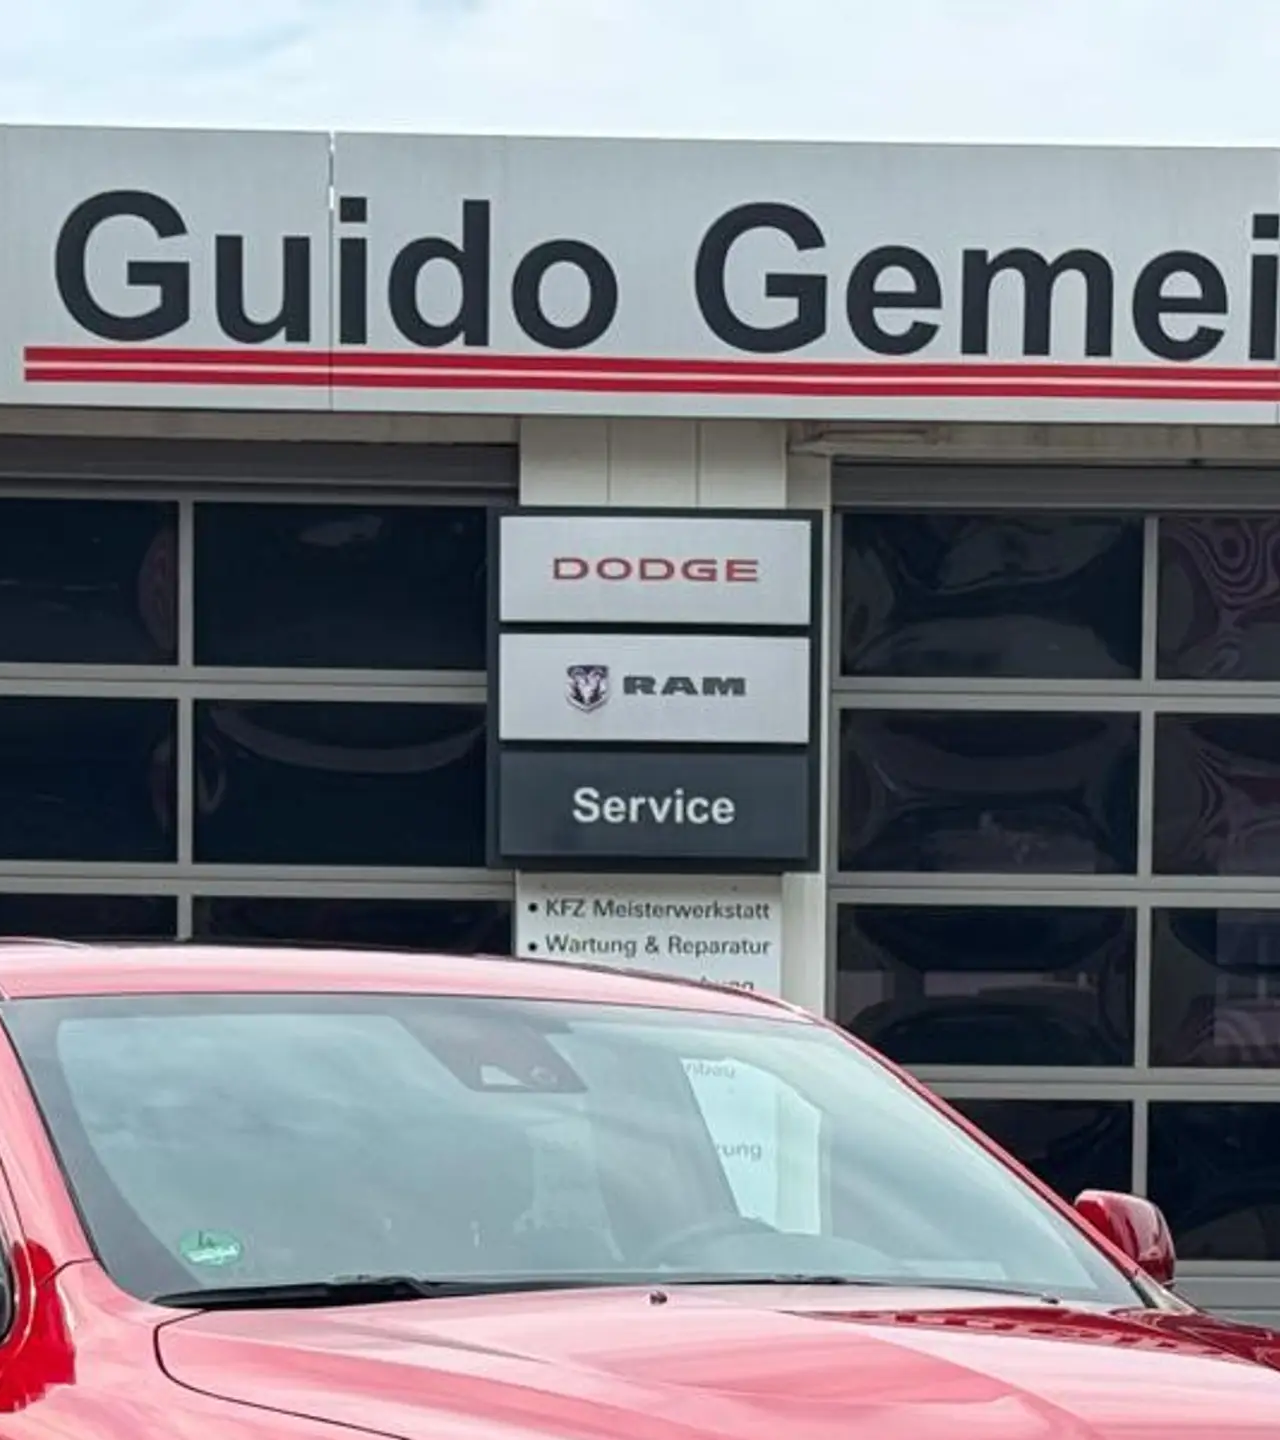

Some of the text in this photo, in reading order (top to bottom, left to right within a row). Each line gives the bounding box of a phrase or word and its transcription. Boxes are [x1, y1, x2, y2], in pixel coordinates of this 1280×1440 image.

[56, 190, 618, 349] Guido
[552, 557, 760, 583] DODGE
[623, 674, 747, 697] RAM
[573, 787, 736, 825] Service
[545, 900, 771, 920] KFZ Meisterwerkstatt
[545, 934, 772, 957] Wartung & Reparatur
